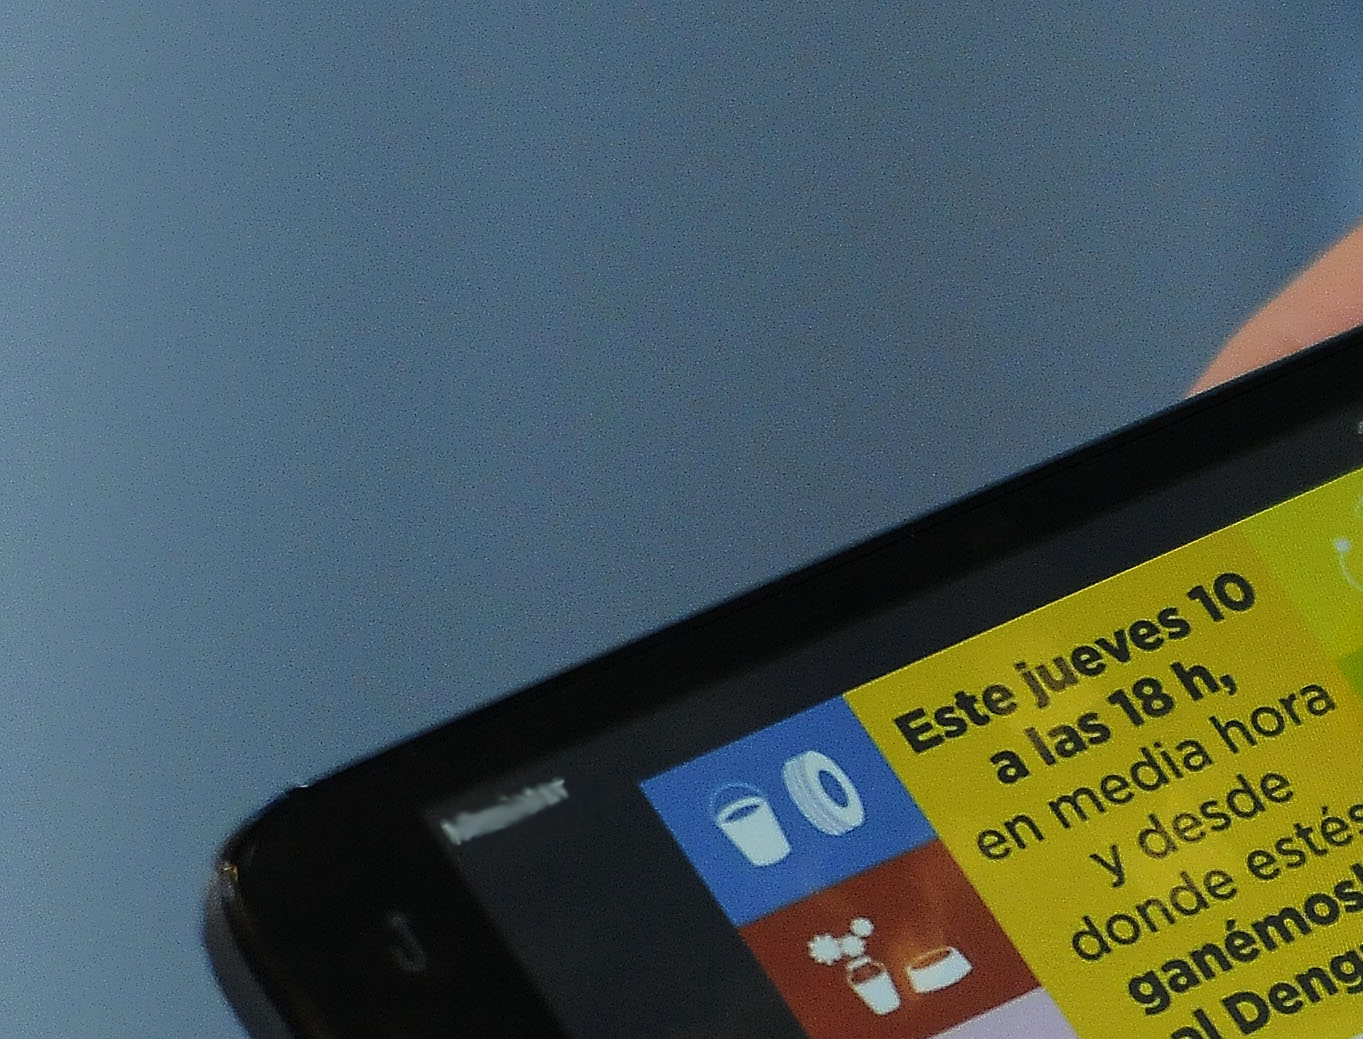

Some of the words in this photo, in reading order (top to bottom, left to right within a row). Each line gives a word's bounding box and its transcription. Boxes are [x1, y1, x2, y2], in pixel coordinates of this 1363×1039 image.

[893, 685, 1017, 754] Este
[1014, 608, 1191, 709] jueves
[1187, 573, 1255, 622] 10
[990, 750, 1029, 784] a
[1027, 712, 1111, 766] las
[1108, 678, 1175, 727] 18
[1170, 662, 1237, 701] h,
[977, 815, 1044, 859] en
[1049, 740, 1213, 829] media
[1209, 685, 1336, 754] hora
[1089, 845, 1125, 888] y
[1138, 773, 1294, 858] desde
[1072, 871, 1237, 961] donde
